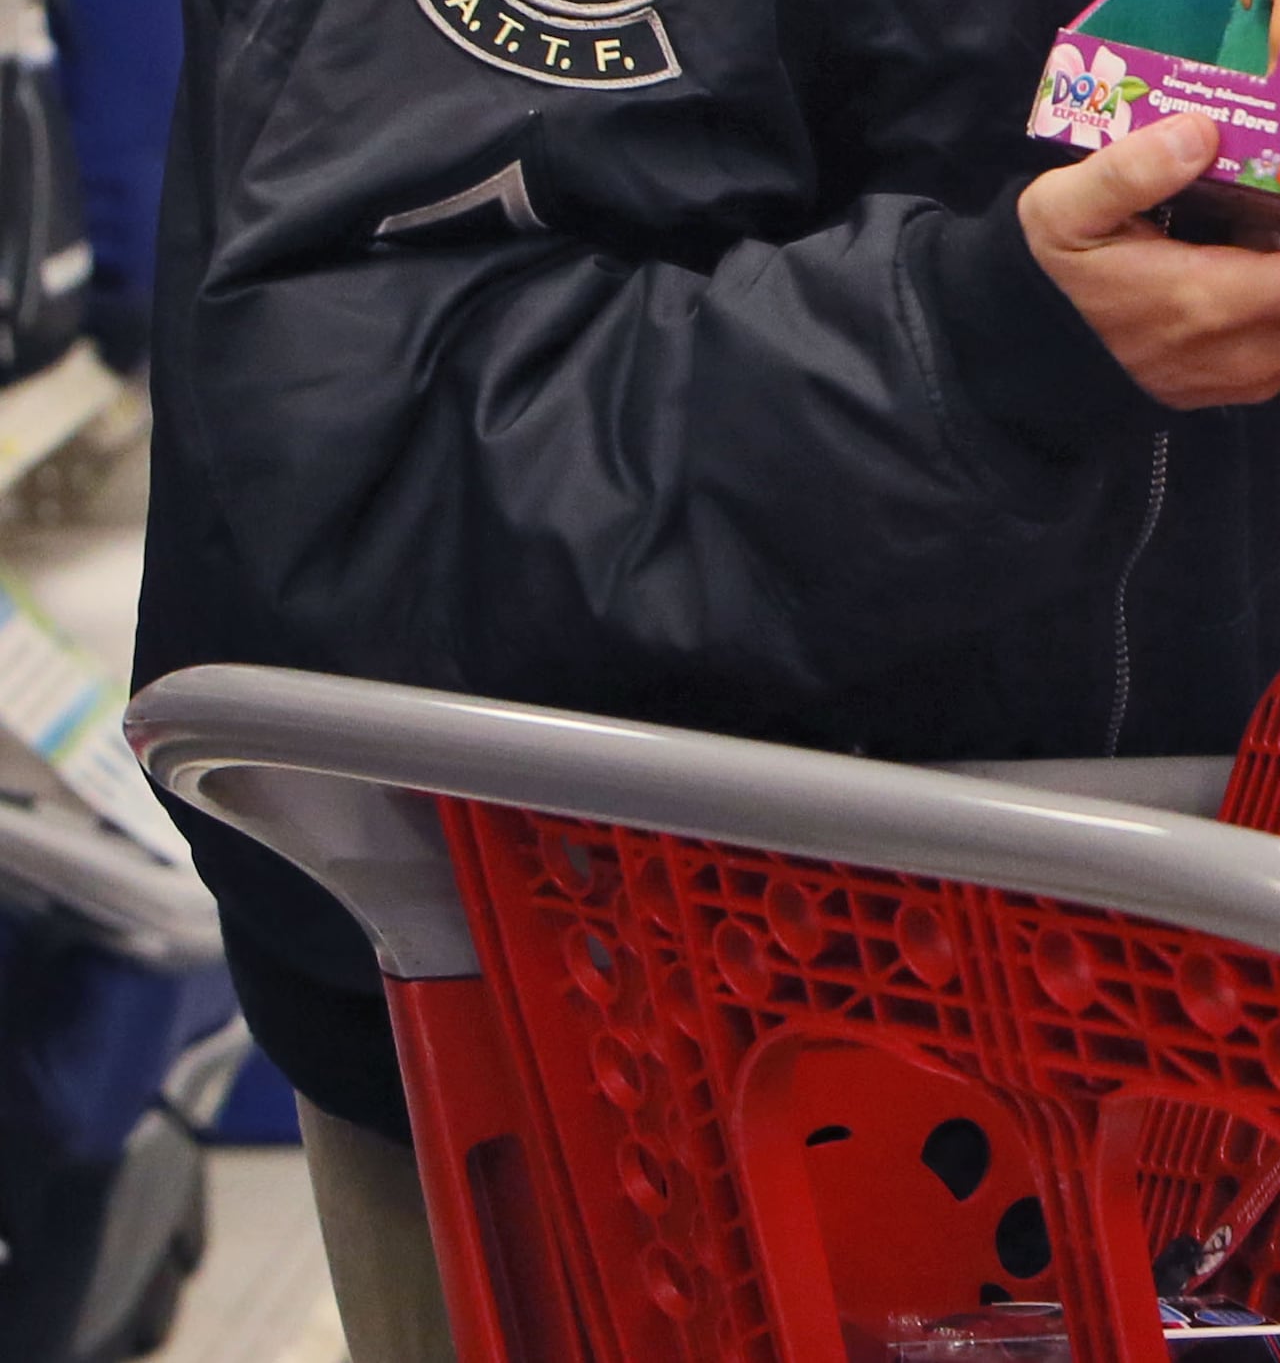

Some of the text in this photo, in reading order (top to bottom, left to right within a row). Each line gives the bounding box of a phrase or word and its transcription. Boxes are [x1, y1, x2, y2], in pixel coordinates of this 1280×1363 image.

[1052, 70, 1122, 120] DORA
[1148, 89, 1279, 134] Gymnast Dora
[1052, 107, 1112, 129] EXPLORER
